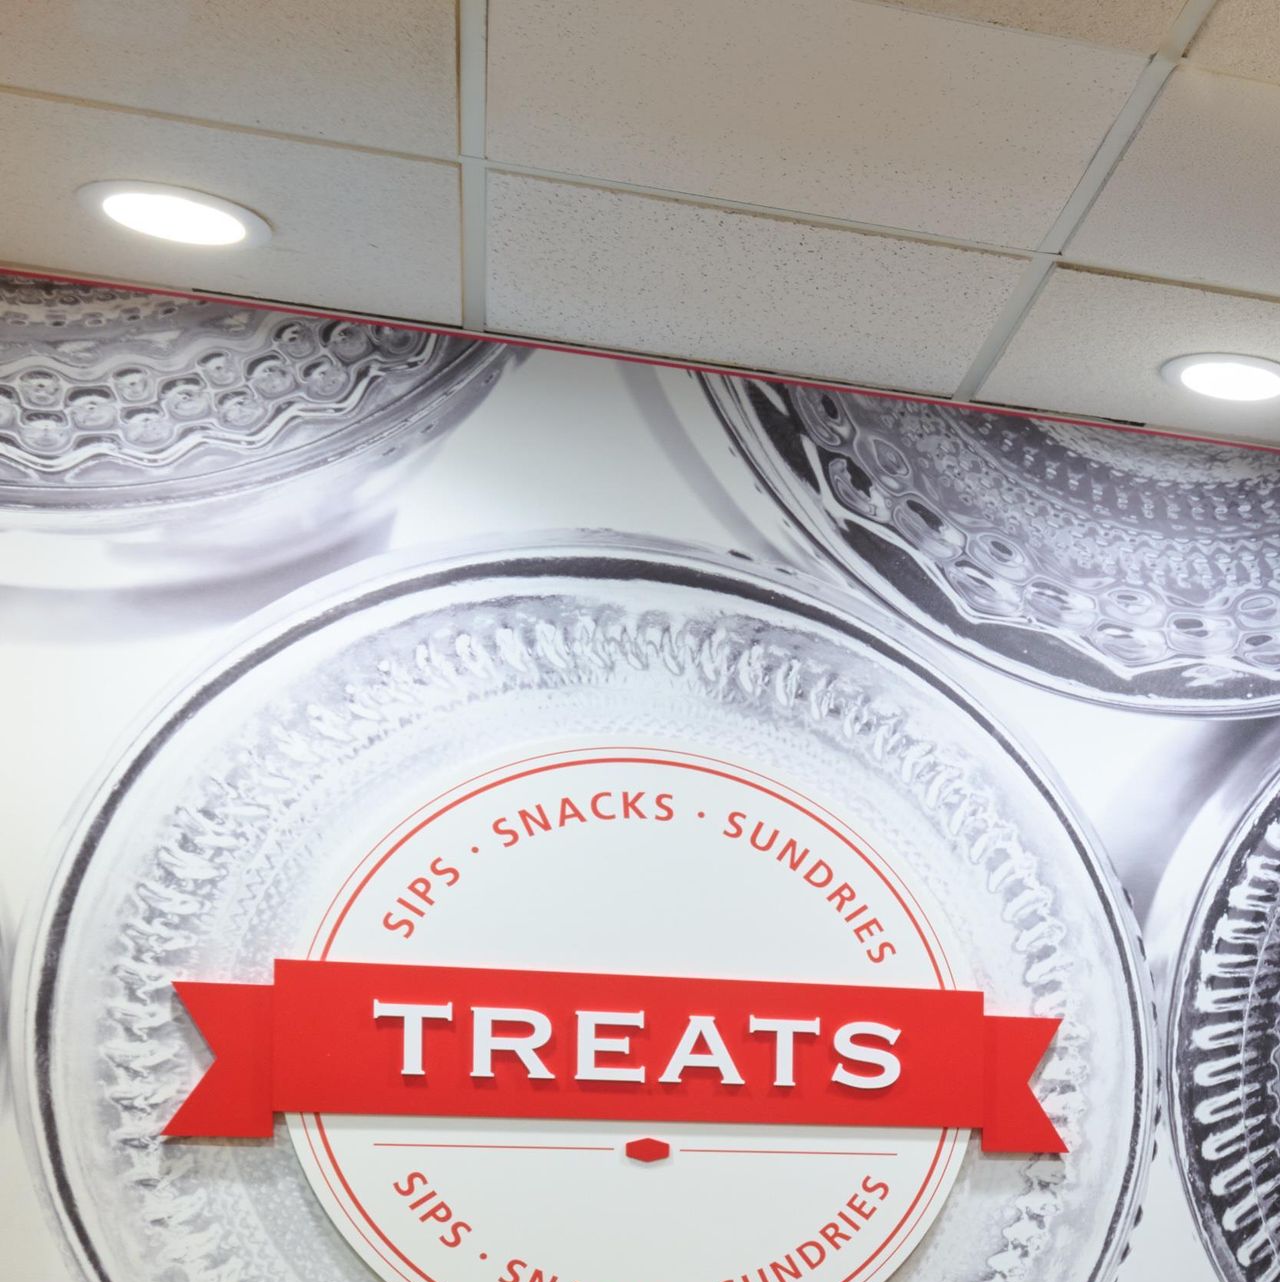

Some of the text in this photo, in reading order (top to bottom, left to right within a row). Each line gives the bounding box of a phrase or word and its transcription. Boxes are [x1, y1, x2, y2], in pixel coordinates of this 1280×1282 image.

[381, 790, 899, 966] SIPS SNACKS SUNDRIES
[372, 998, 904, 1091] TREATS
[393, 1170, 473, 1249] SIPS
